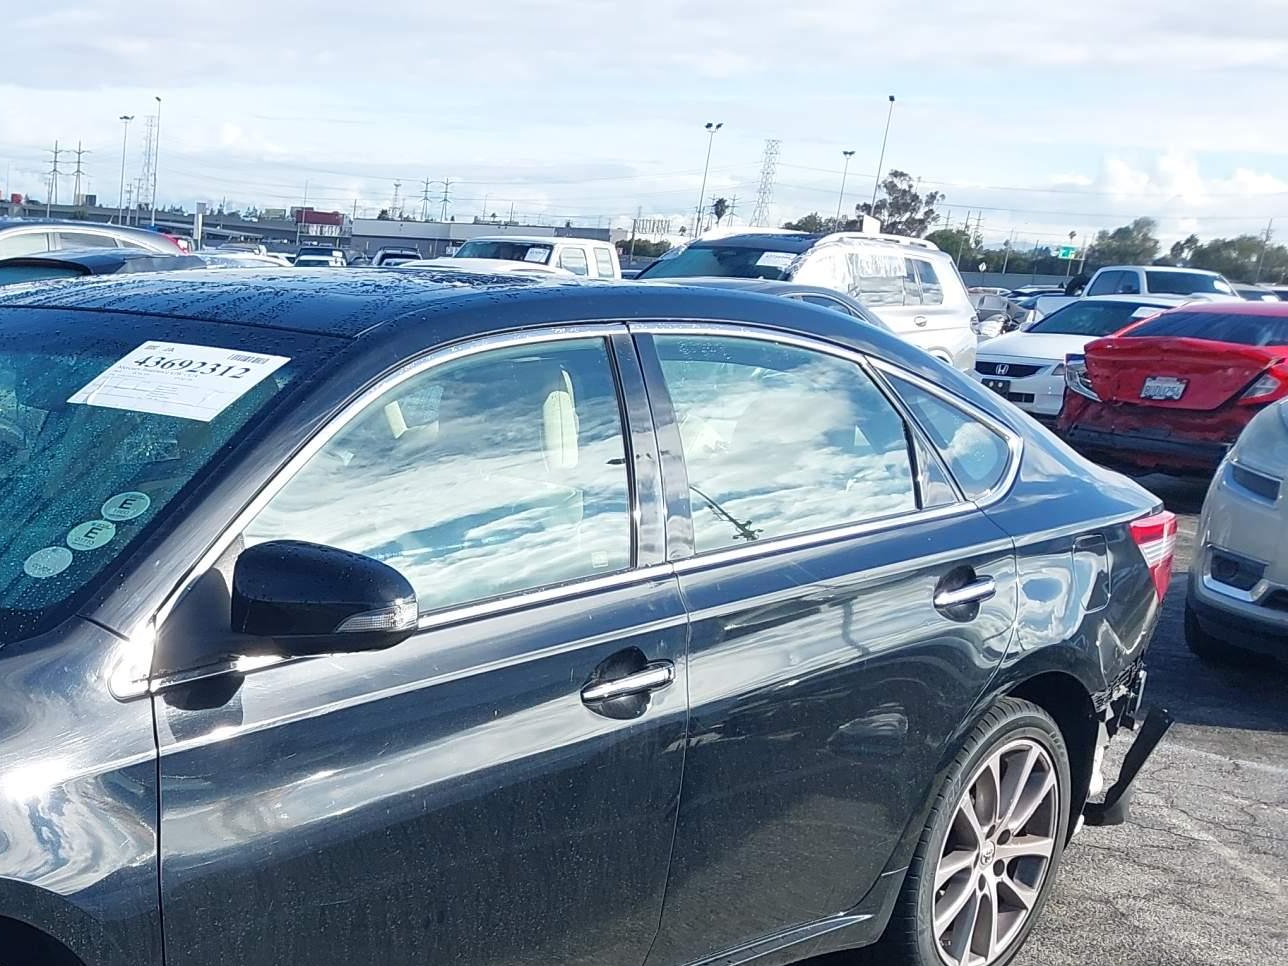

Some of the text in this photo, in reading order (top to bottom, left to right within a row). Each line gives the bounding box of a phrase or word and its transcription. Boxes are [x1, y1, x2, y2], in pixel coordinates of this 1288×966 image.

[134, 355, 252, 379] 43692312
[118, 498, 137, 510] E
[82, 526, 104, 539] E
